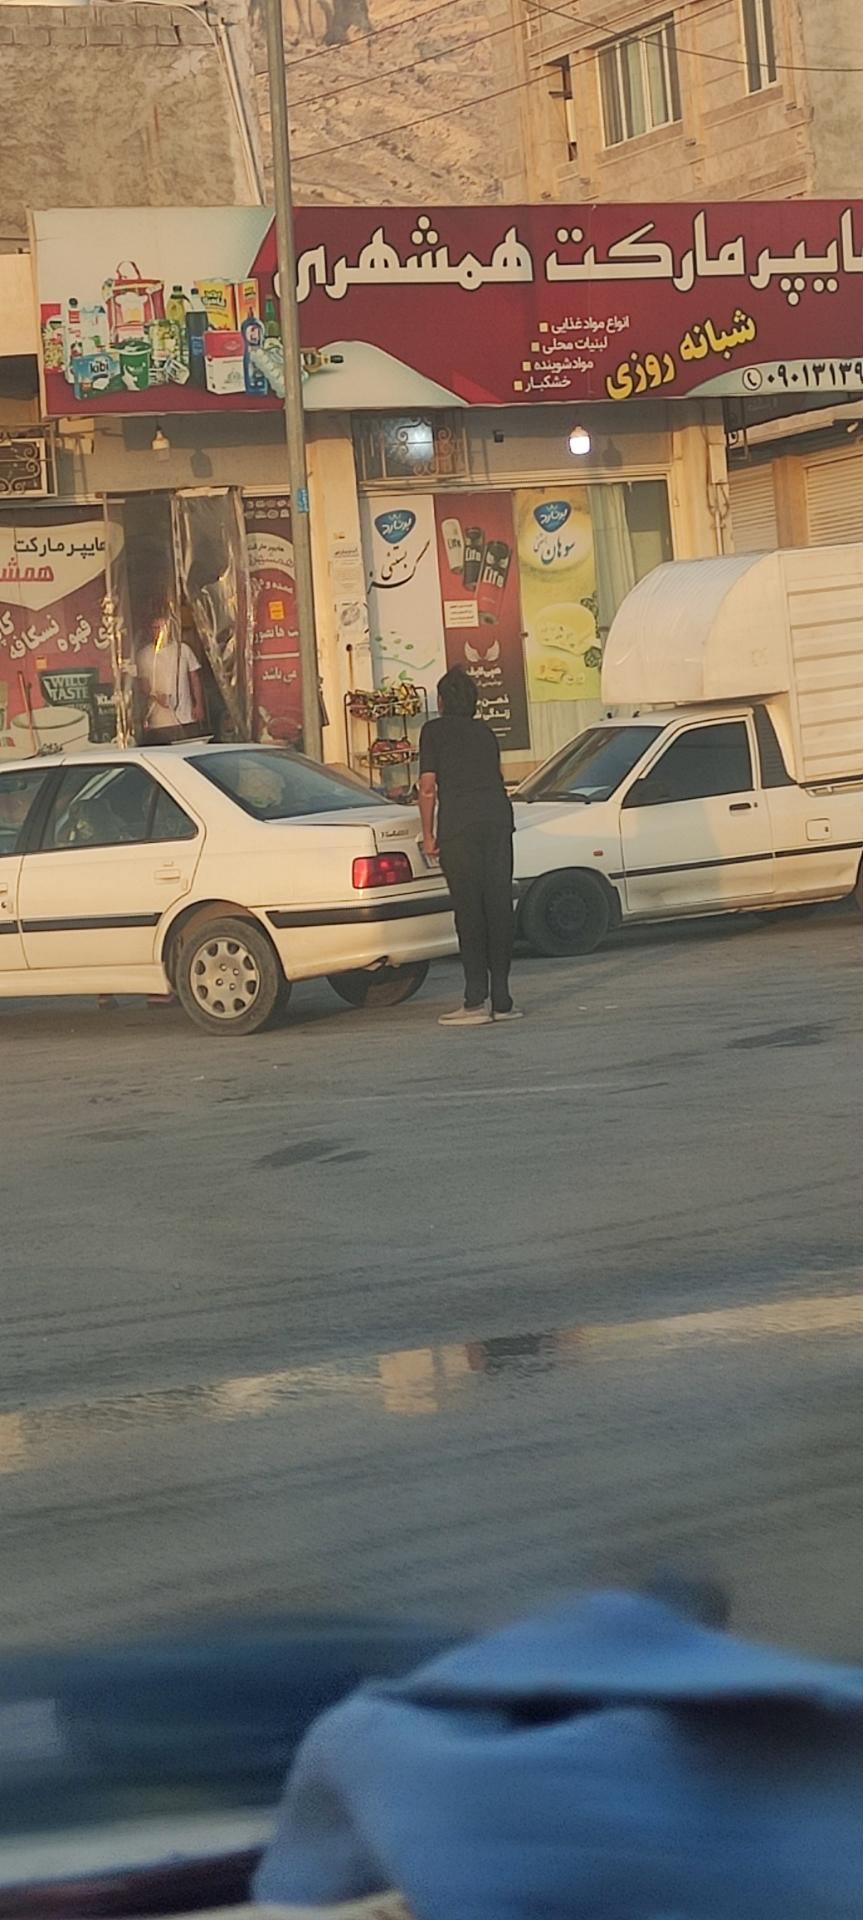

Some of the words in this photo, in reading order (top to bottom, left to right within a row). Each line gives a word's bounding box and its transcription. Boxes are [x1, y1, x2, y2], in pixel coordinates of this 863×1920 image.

[273, 215, 534, 302] همشهری
[546, 210, 746, 292] مارکت
[749, 208, 863, 306] ایپر
[551, 317, 582, 334] غذایی
[583, 317, 605, 332] مواد
[606, 315, 630, 333] انواع
[574, 336, 608, 352] لبنیات
[680, 309, 757, 361] شبانه
[542, 338, 573, 354] محلی
[534, 358, 573, 373] شوینده
[572, 357, 594, 372] مواد
[524, 374, 571, 392] خشکبار
[606, 352, 676, 400] روزی
[13, 537, 65, 557] مارکت
[381, 545, 408, 580] بستنی
[10, 614, 59, 659] نسکافه
[57, 614, 92, 653] قهوه
